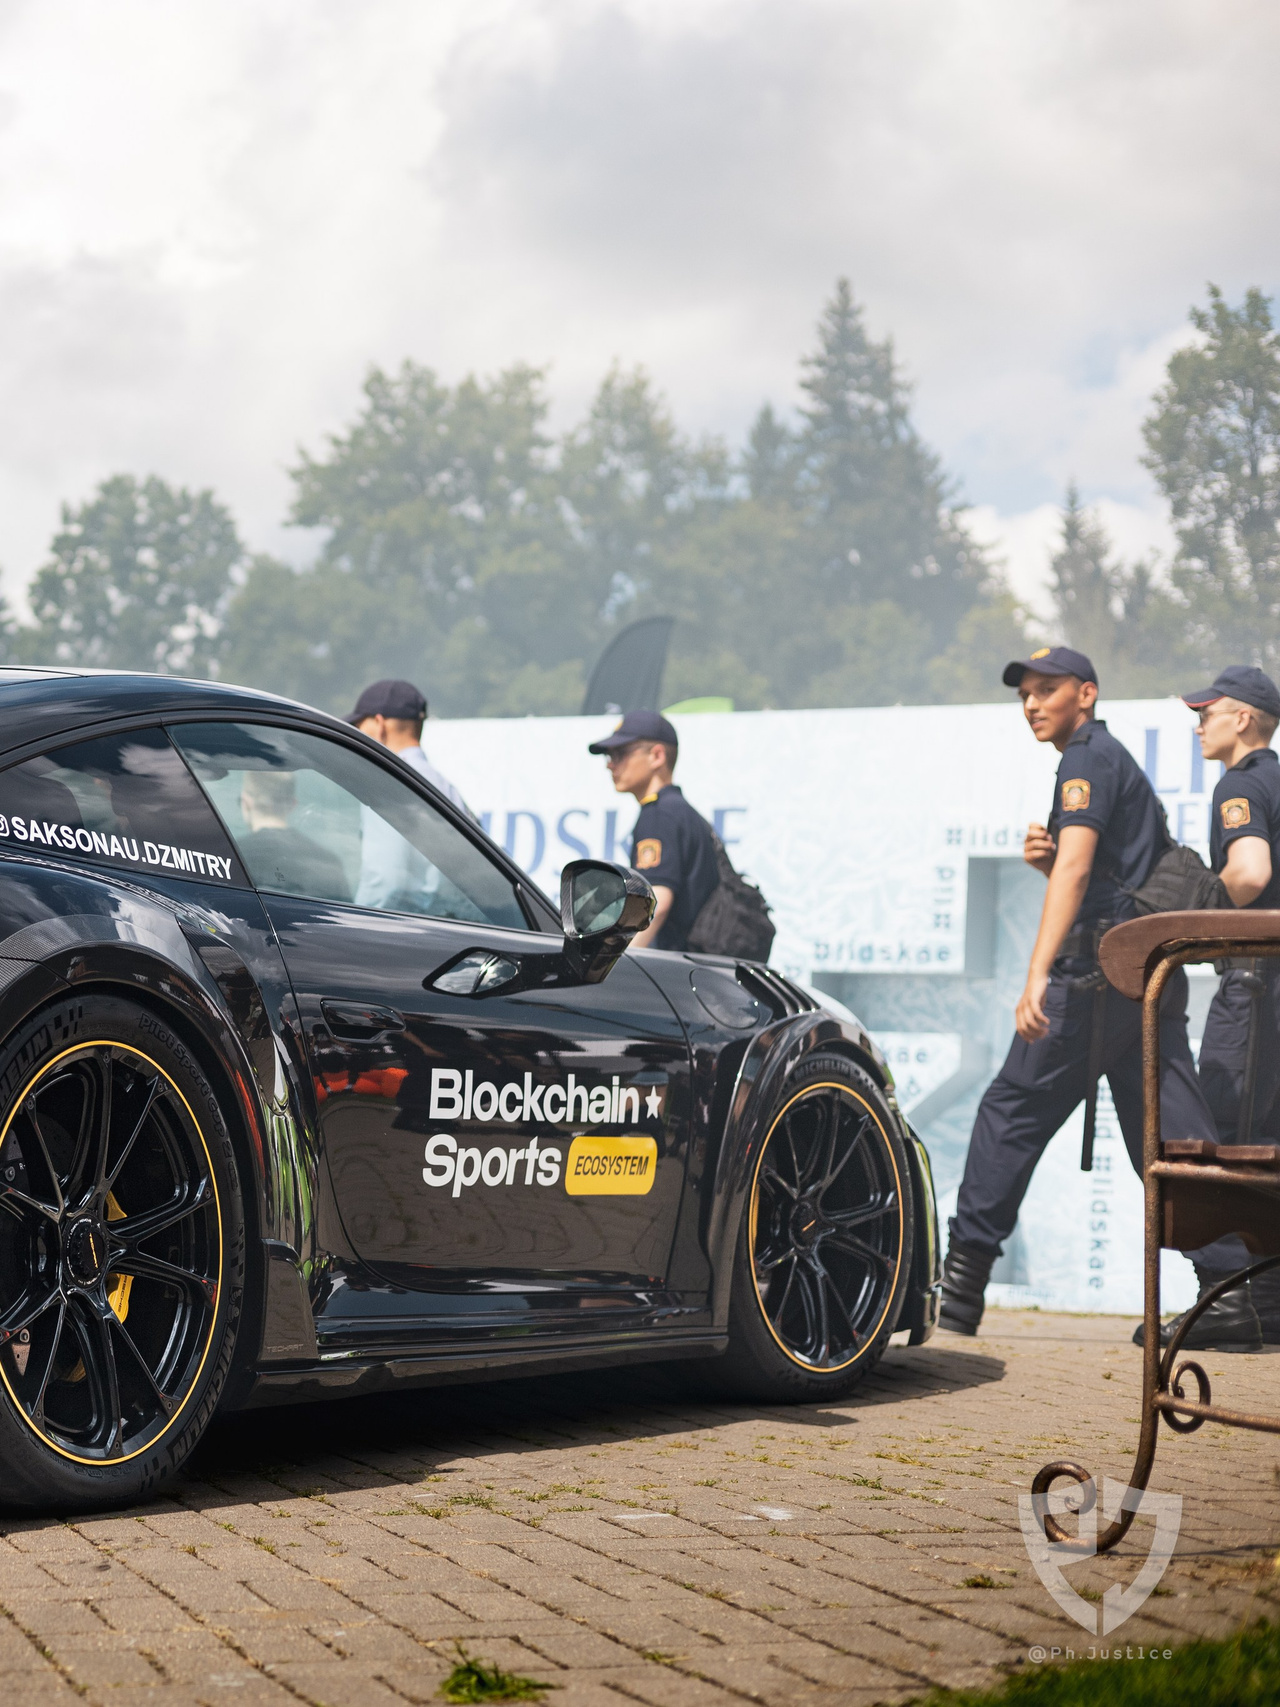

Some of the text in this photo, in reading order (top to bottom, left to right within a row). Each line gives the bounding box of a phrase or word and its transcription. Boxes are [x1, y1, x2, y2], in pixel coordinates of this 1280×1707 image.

[138, 1012, 176, 1049] Pilot
[173, 1043, 212, 1097] Sport
[207, 1096, 227, 1139] Cup
[429, 1067, 640, 1124] Blockchain
[422, 1133, 650, 1198] Sports ECOSYSTEM
